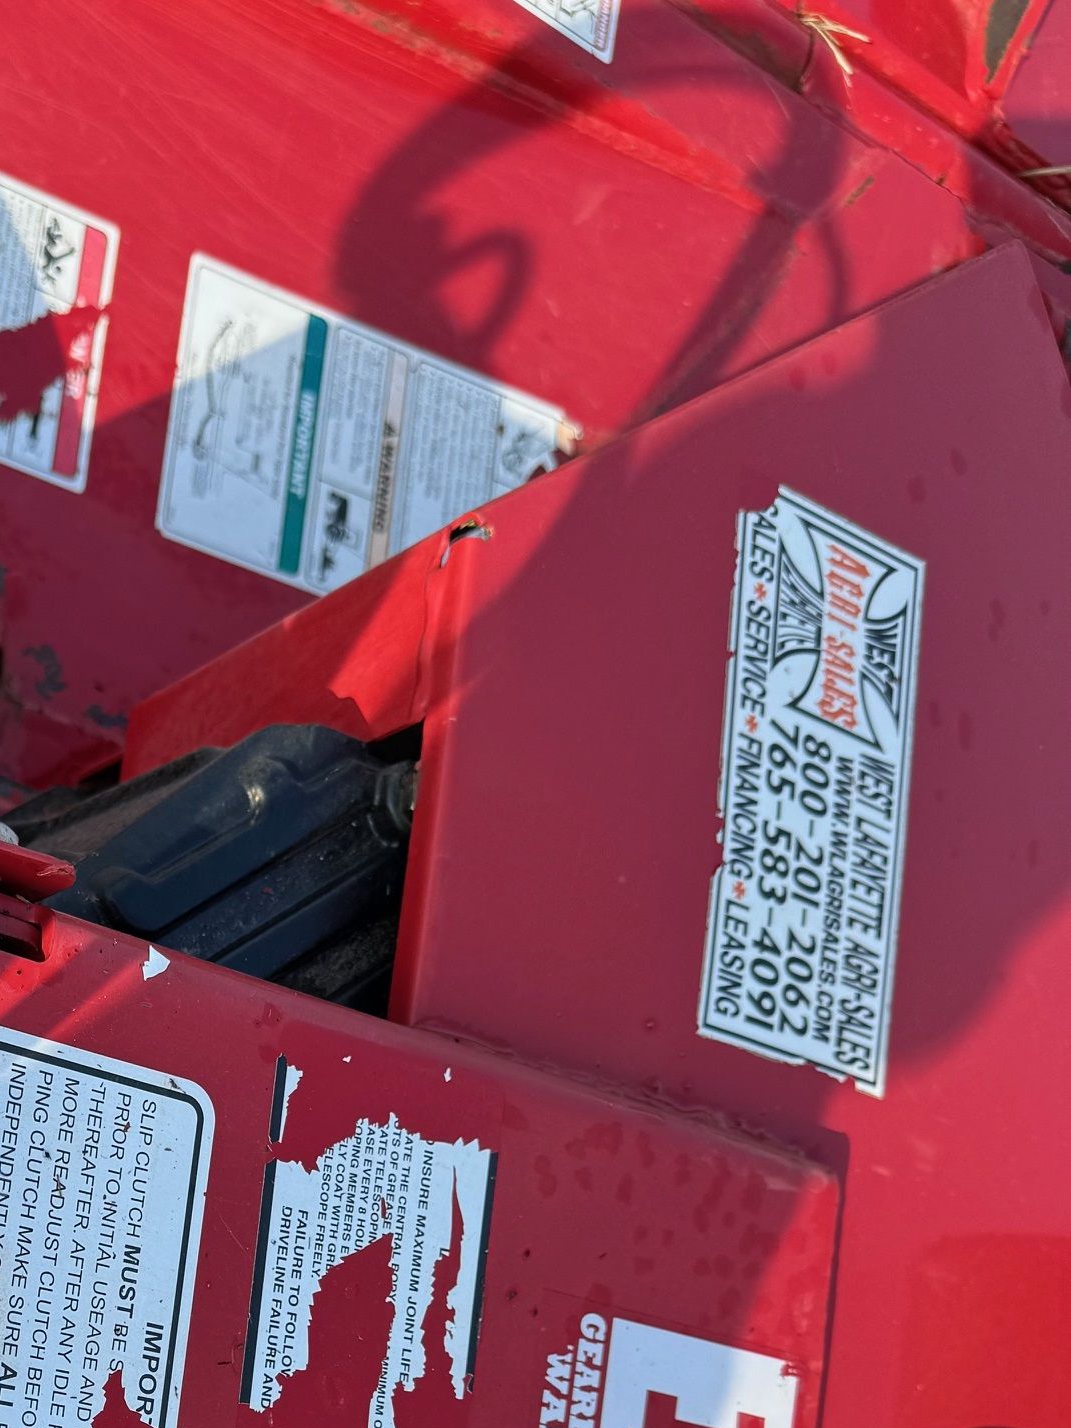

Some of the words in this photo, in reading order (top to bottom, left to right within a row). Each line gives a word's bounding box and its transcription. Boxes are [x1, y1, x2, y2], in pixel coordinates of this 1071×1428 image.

[290, 391, 315, 498] IMPORTANT
[373, 442, 395, 533] WARNING
[741, 599, 772, 717] SERVICE
[729, 732, 763, 880] FINANCING
[856, 754, 895, 820] WEST
[744, 719, 800, 1032] 765-583-4091
[778, 734, 832, 1037] 800-201-2062
[812, 756, 854, 1044] WWW.WLAGRISALES.COM
[847, 816, 890, 940] LAFAYETTE
[715, 899, 750, 1018] LEASING
[834, 937, 880, 1070] AGRI-SALES
[33, 1069, 54, 1124] PING
[57, 1077, 80, 1144] MORE
[109, 1092, 132, 1160] PRIOR
[139, 1099, 157, 1146] SLIP
[20, 1130, 46, 1220] CLUTCH
[73, 1085, 107, 1233] THEREAFTER.
[105, 1167, 123, 1195] TO
[317, 1146, 334, 1221] ELESCOPE
[333, 1163, 346, 1202] COAT
[359, 1158, 373, 1204] EVERY
[389, 1150, 400, 1170] OF
[399, 1166, 411, 1192] THE
[417, 1150, 434, 1210] INSURE
[42, 1148, 71, 1267] READJUST
[126, 1151, 150, 1238] CLUTCH
[328, 1205, 342, 1240] WITH
[342, 1172, 358, 1242] MEMBERS
[358, 1206, 367, 1215] 8
[382, 1173, 397, 1230] GREASE
[392, 1198, 407, 1258] CENTRAL
[11, 1225, 34, 1289] MAKE
[94, 1201, 118, 1274] INITIAL
[273, 1205, 293, 1294] DRIVELINE
[291, 1209, 309, 1280] FAILURE
[311, 1224, 326, 1278] FREELY.
[408, 1214, 427, 1292] MAXIMUM
[62, 1238, 86, 1312] AFTER
[116, 1244, 142, 1319] MUST
[288, 1284, 301, 1307] TO
[2, 1294, 25, 1358] SURE
[29, 1271, 55, 1361] CLUTCH
[57, 1315, 76, 1363] ANY
[82, 1280, 108, 1372] USEAGE
[111, 1323, 129, 1353] BE
[264, 1298, 283, 1370] FAILURE
[403, 1296, 417, 1345] JOINT
[49, 1368, 70, 1418] IDLE
[76, 1374, 95, 1422] AND
[134, 1321, 164, 1426] IMPOR
[260, 1372, 274, 1410] AND
[399, 1348, 412, 1383] LIFE
